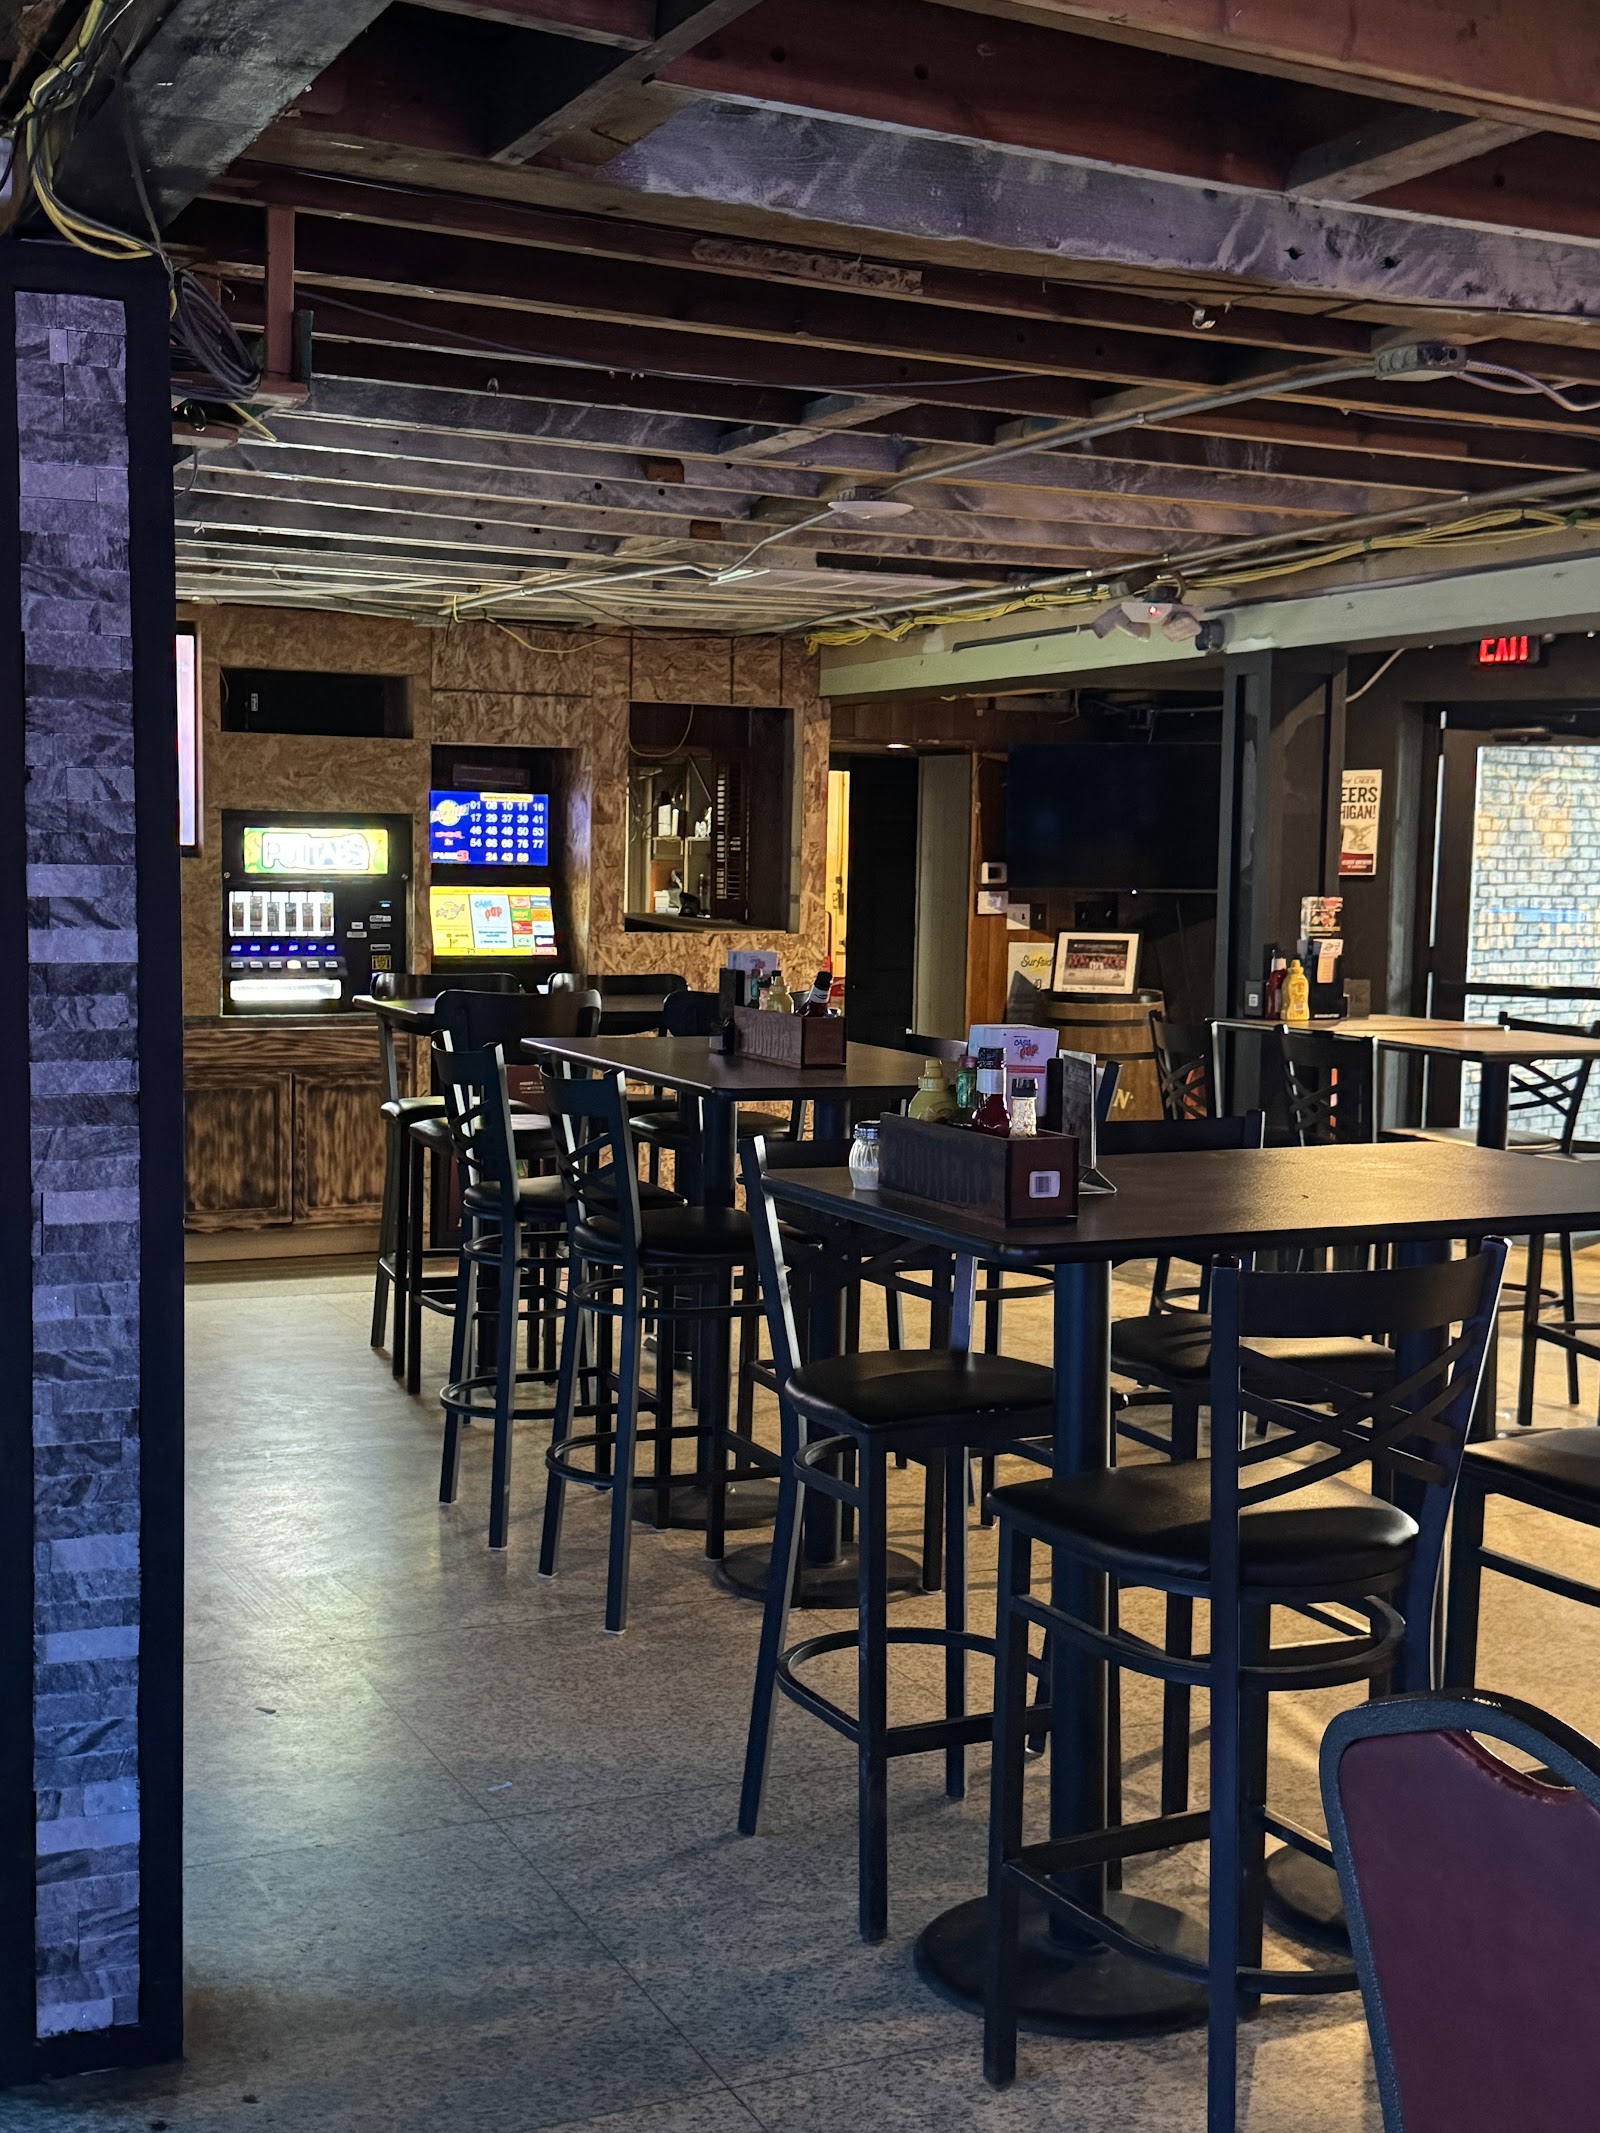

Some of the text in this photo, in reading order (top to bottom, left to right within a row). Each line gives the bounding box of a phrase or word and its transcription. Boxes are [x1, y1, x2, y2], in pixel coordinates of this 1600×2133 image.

[470, 801, 480, 809] 01
[502, 801, 513, 810] 10
[518, 802, 527, 811] 11
[533, 803, 544, 811] 16
[471, 813, 482, 822] 17
[486, 814, 497, 822] 29
[502, 814, 513, 823] 37
[532, 815, 543, 824] 41
[470, 838, 482, 847] 54
[533, 839, 544, 848] 77
[486, 852, 497, 861] 24
